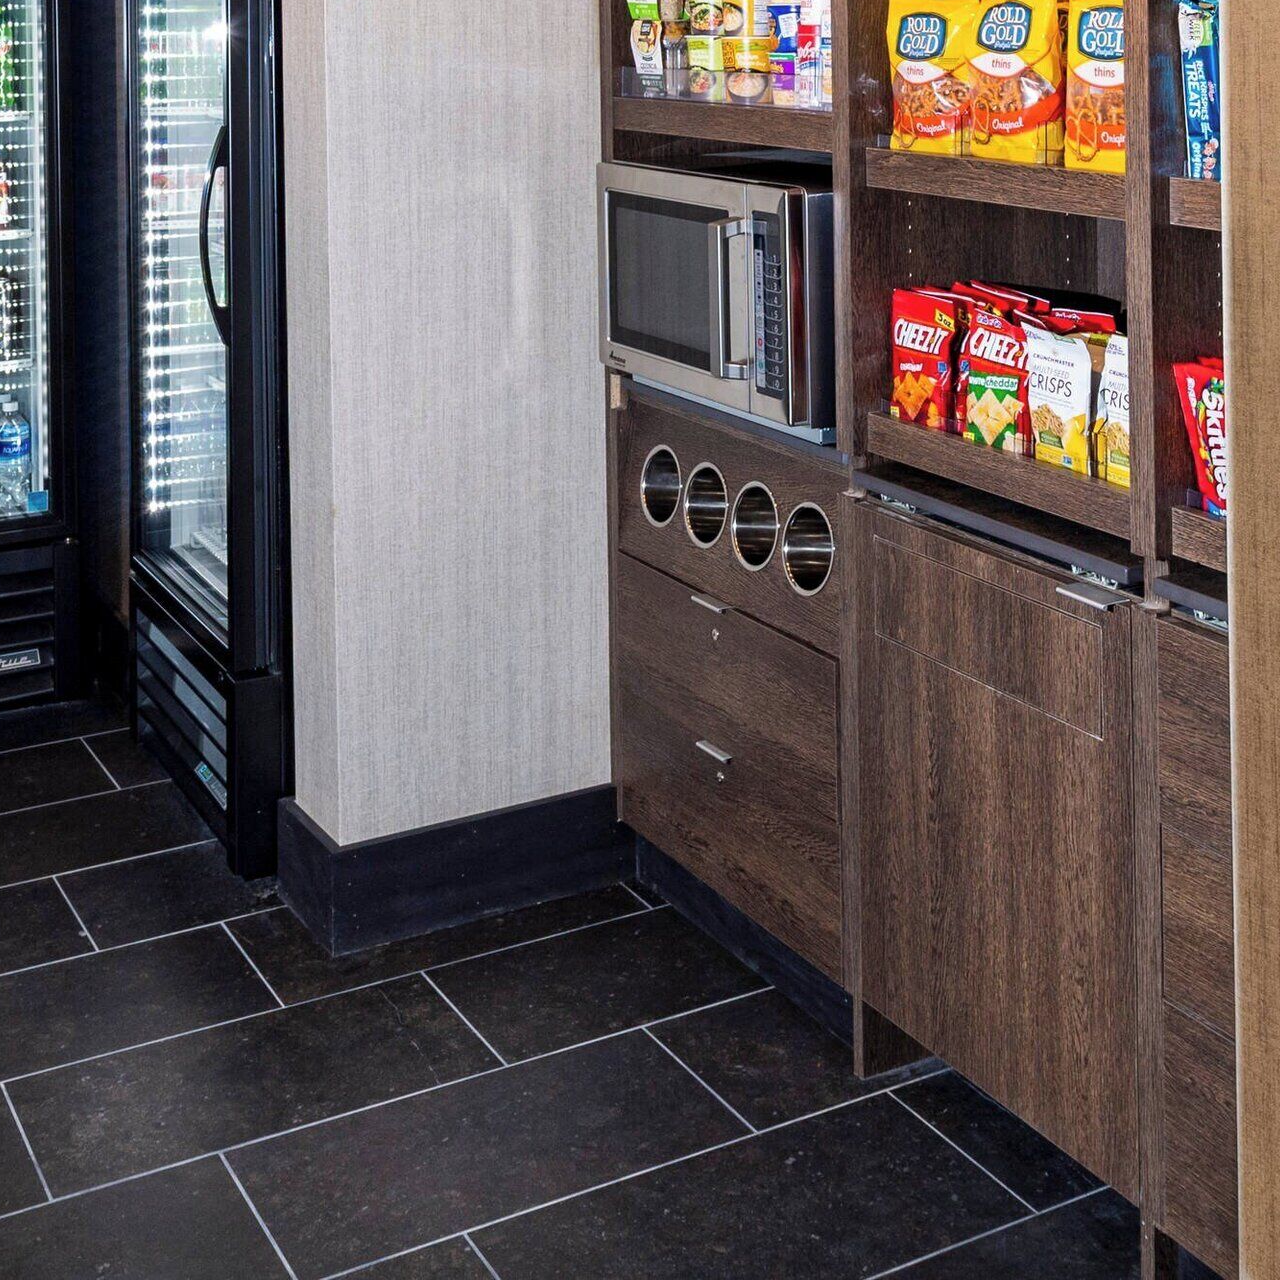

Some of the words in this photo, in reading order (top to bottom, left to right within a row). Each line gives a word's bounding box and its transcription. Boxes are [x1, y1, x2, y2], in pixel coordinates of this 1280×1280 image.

[989, 6, 1026, 24] ROLD
[907, 16, 940, 34] ROLD
[981, 23, 1026, 46] GOLD
[899, 33, 940, 55] GOLD
[906, 65, 924, 77] thins
[992, 58, 1011, 70] thins
[1094, 66, 1116, 78] thins
[1185, 62, 1201, 120] TREATS
[1194, 60, 1203, 80] RICE
[1199, 81, 1210, 120] KRISPIES
[916, 122, 946, 135] Original
[992, 118, 1024, 131] Original
[937, 313, 944, 321] 3
[943, 318, 952, 328] oz
[1033, 353, 1075, 368] CRUNCHMASTER
[986, 377, 1018, 390] cheddar
[1030, 371, 1073, 398] CRISPS
